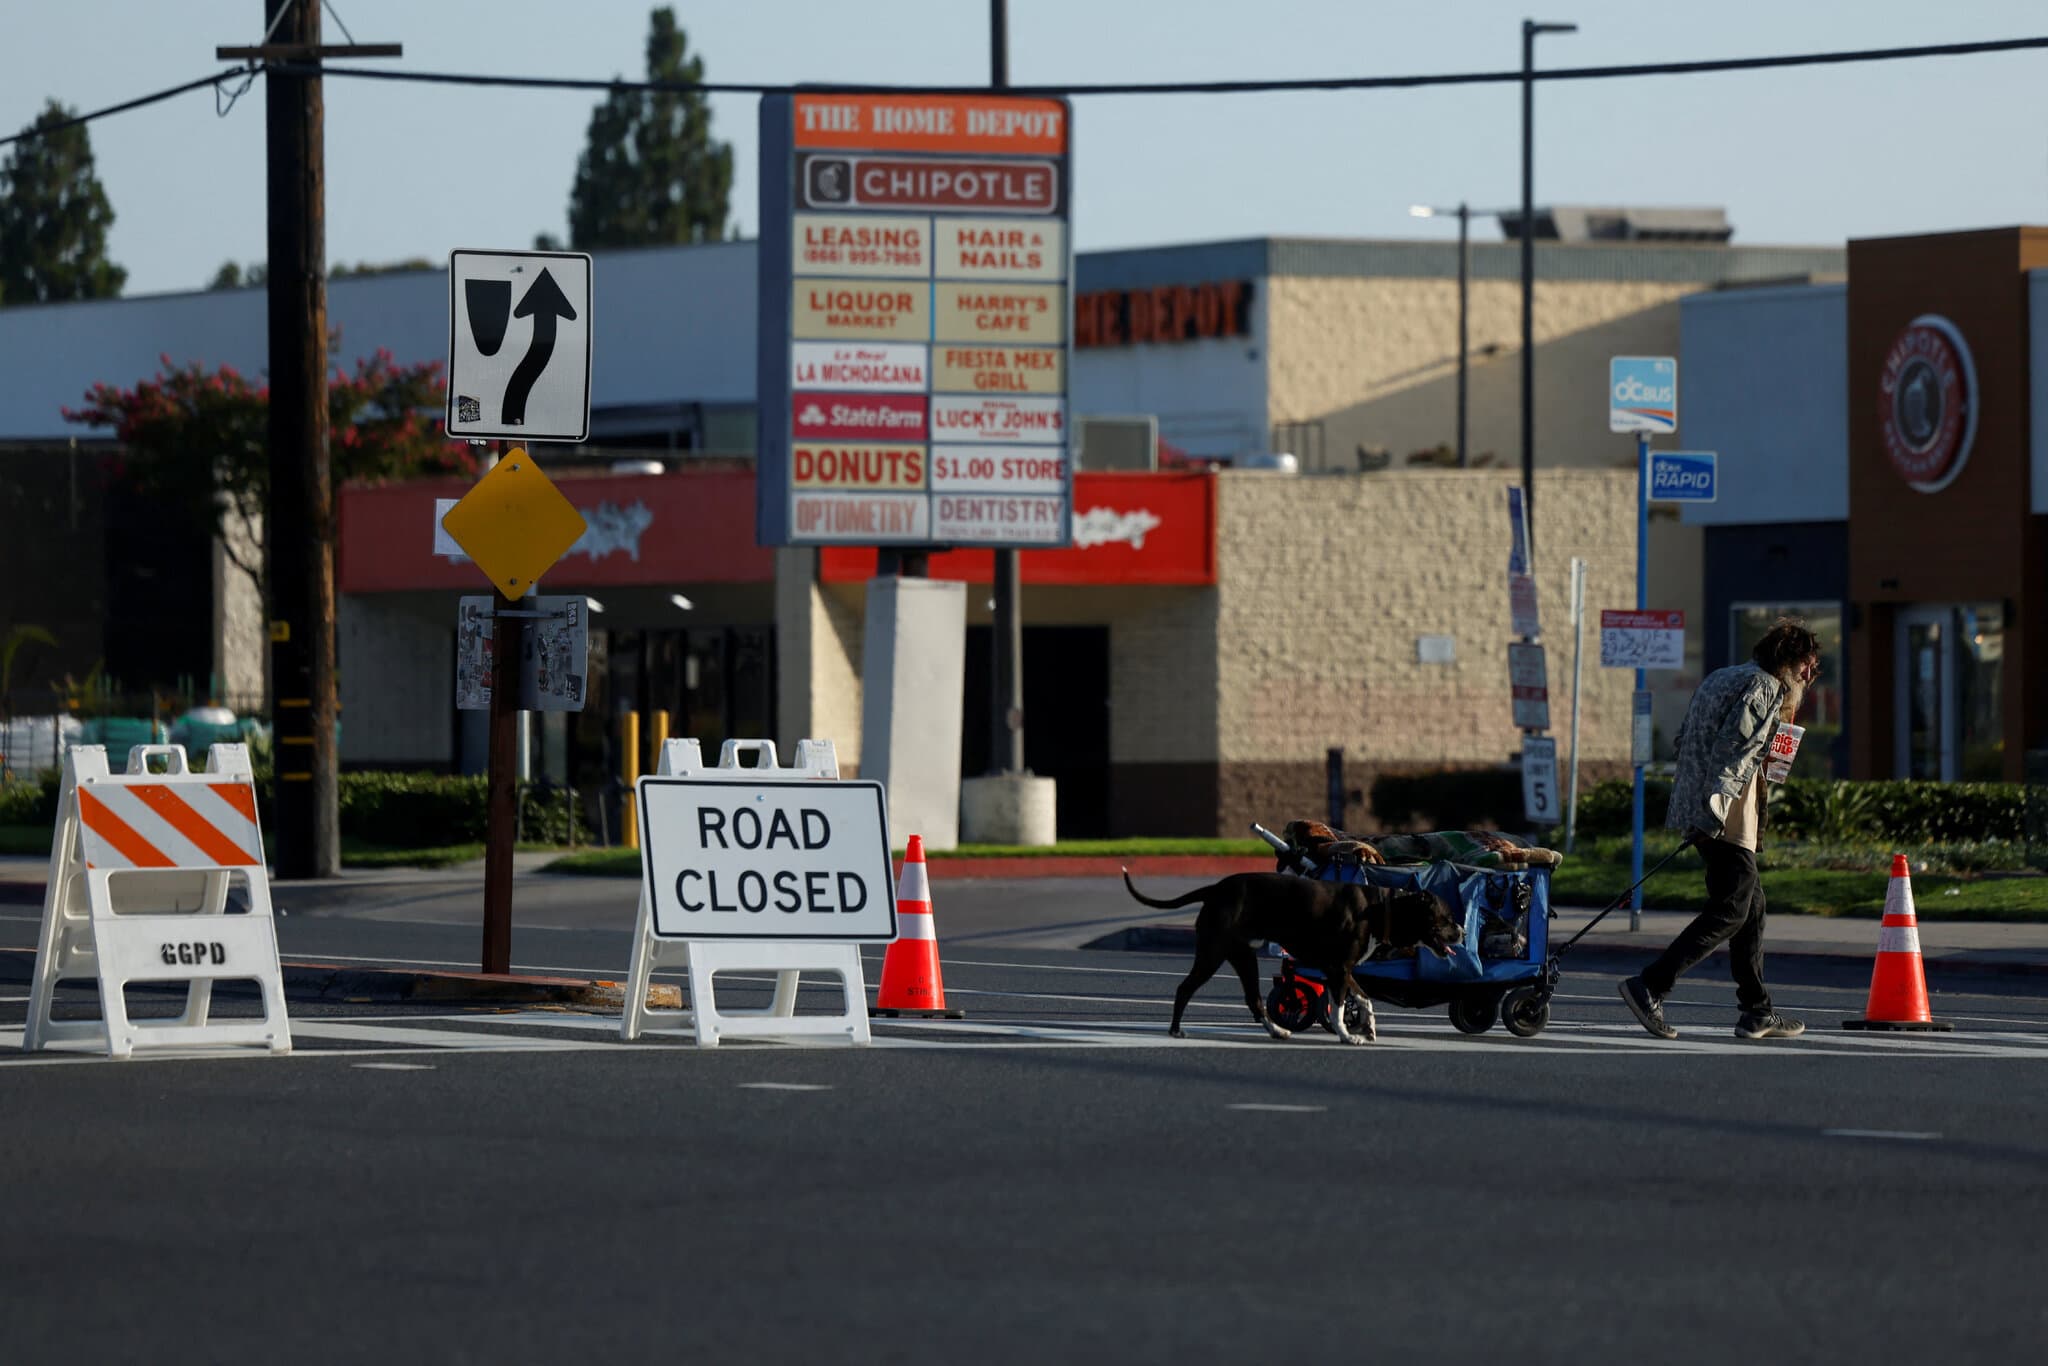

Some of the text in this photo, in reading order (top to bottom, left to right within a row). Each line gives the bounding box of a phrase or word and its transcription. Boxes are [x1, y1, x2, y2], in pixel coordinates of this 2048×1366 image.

[800, 103, 1062, 138] THE HOME DEPOT
[863, 168, 1045, 201] CHIPOTLE
[805, 227, 920, 248] LEASING
[958, 230, 1024, 247] HAIR
[960, 251, 1042, 269] NAILS
[810, 291, 913, 314] LIQUOR
[958, 294, 1048, 312] HARRY'S
[826, 315, 897, 328] MARKET
[976, 315, 1030, 331] CAFE
[945, 349, 1055, 370] FIESTA MEX
[796, 363, 923, 384] LA MICHOACANA
[973, 371, 1029, 391] GRILL
[935, 410, 1064, 431] LUCKY JOHN'S
[794, 449, 923, 484] DONUTS
[935, 457, 1065, 480] $1.00 STORE
[1653, 472, 1711, 490] RAPID
[796, 499, 918, 533] OPTOMETRY
[939, 499, 1062, 523] DENTISTRY
[1534, 782, 1548, 812] 5
[697, 807, 831, 850] ROAD
[675, 869, 867, 913] CLOSED
[160, 943, 225, 965] GGPD
